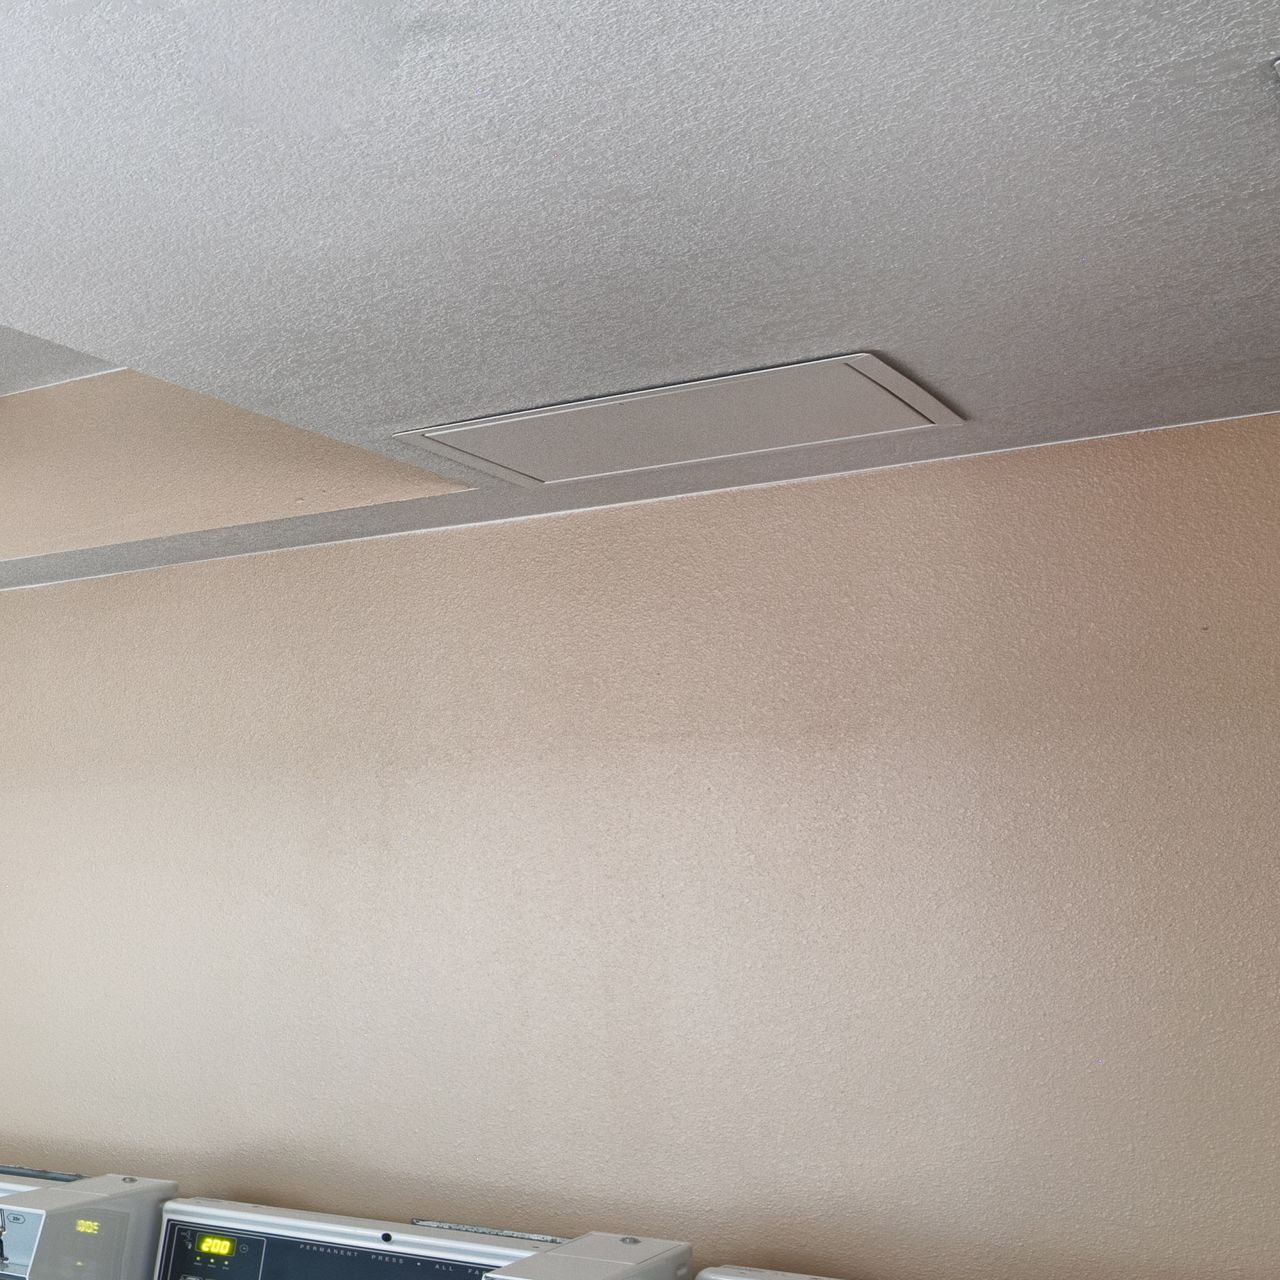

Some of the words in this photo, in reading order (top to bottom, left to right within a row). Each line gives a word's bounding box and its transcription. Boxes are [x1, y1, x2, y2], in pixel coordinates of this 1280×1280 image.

[201, 1238, 231, 1255] 200
[299, 1244, 359, 1257] PERMANENT
[371, 1254, 404, 1264] PRESS
[435, 1263, 454, 1272] ALL
